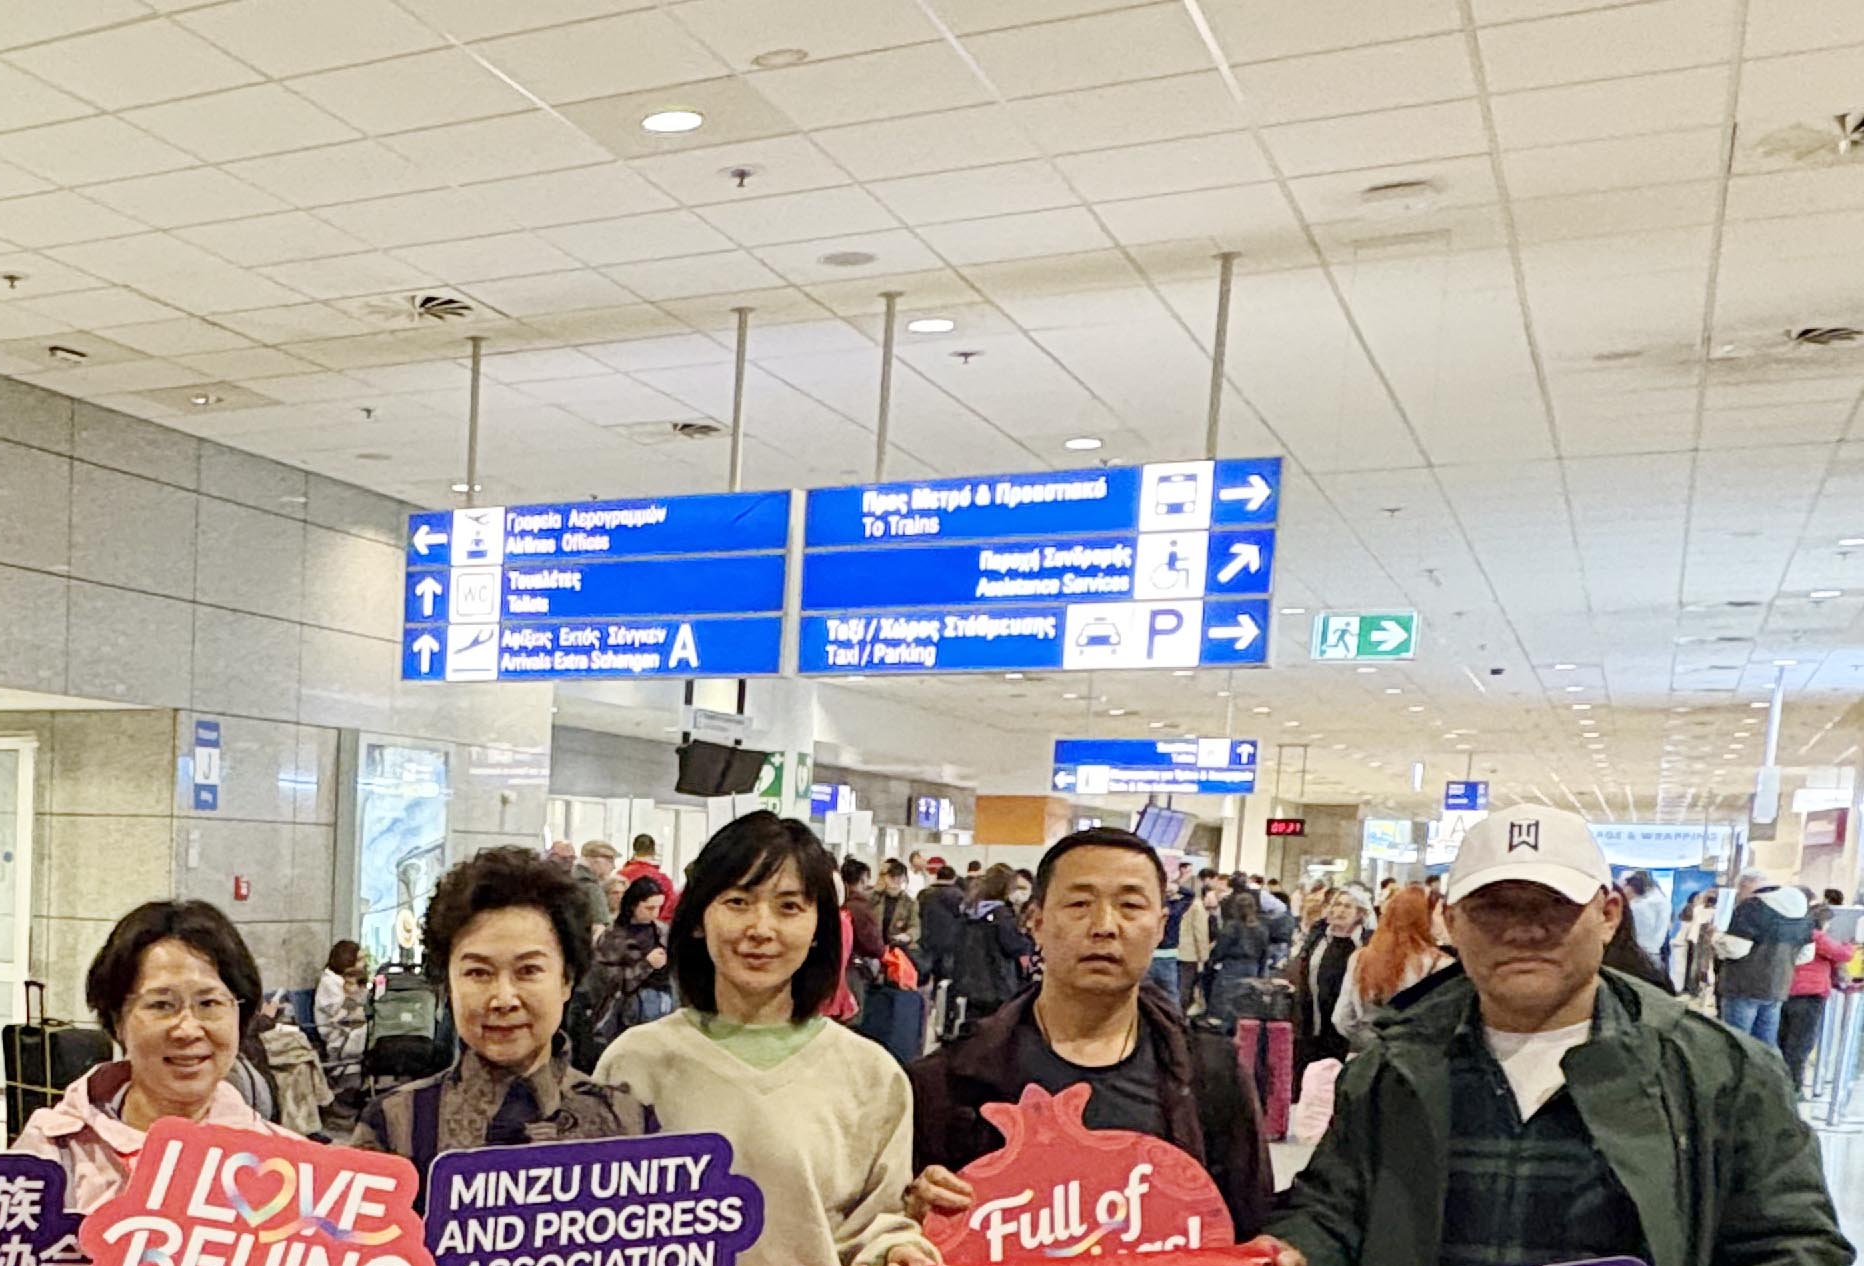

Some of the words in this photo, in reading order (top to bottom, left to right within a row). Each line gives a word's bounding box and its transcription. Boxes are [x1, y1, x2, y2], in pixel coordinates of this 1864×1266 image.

[862, 516, 885, 538] To
[888, 514, 940, 536] Trains
[668, 623, 699, 669] A
[825, 645, 860, 667] Taxi
[873, 644, 936, 668] Parking
[1146, 608, 1184, 660] P
[146, 1139, 183, 1210] I
[449, 1166, 583, 1211] MINZU
[590, 1155, 713, 1198] UNITY
[436, 1210, 527, 1257] AND
[535, 1197, 744, 1249] PROGRESS
[969, 1181, 1087, 1262] Full
[1096, 1163, 1153, 1242] of
